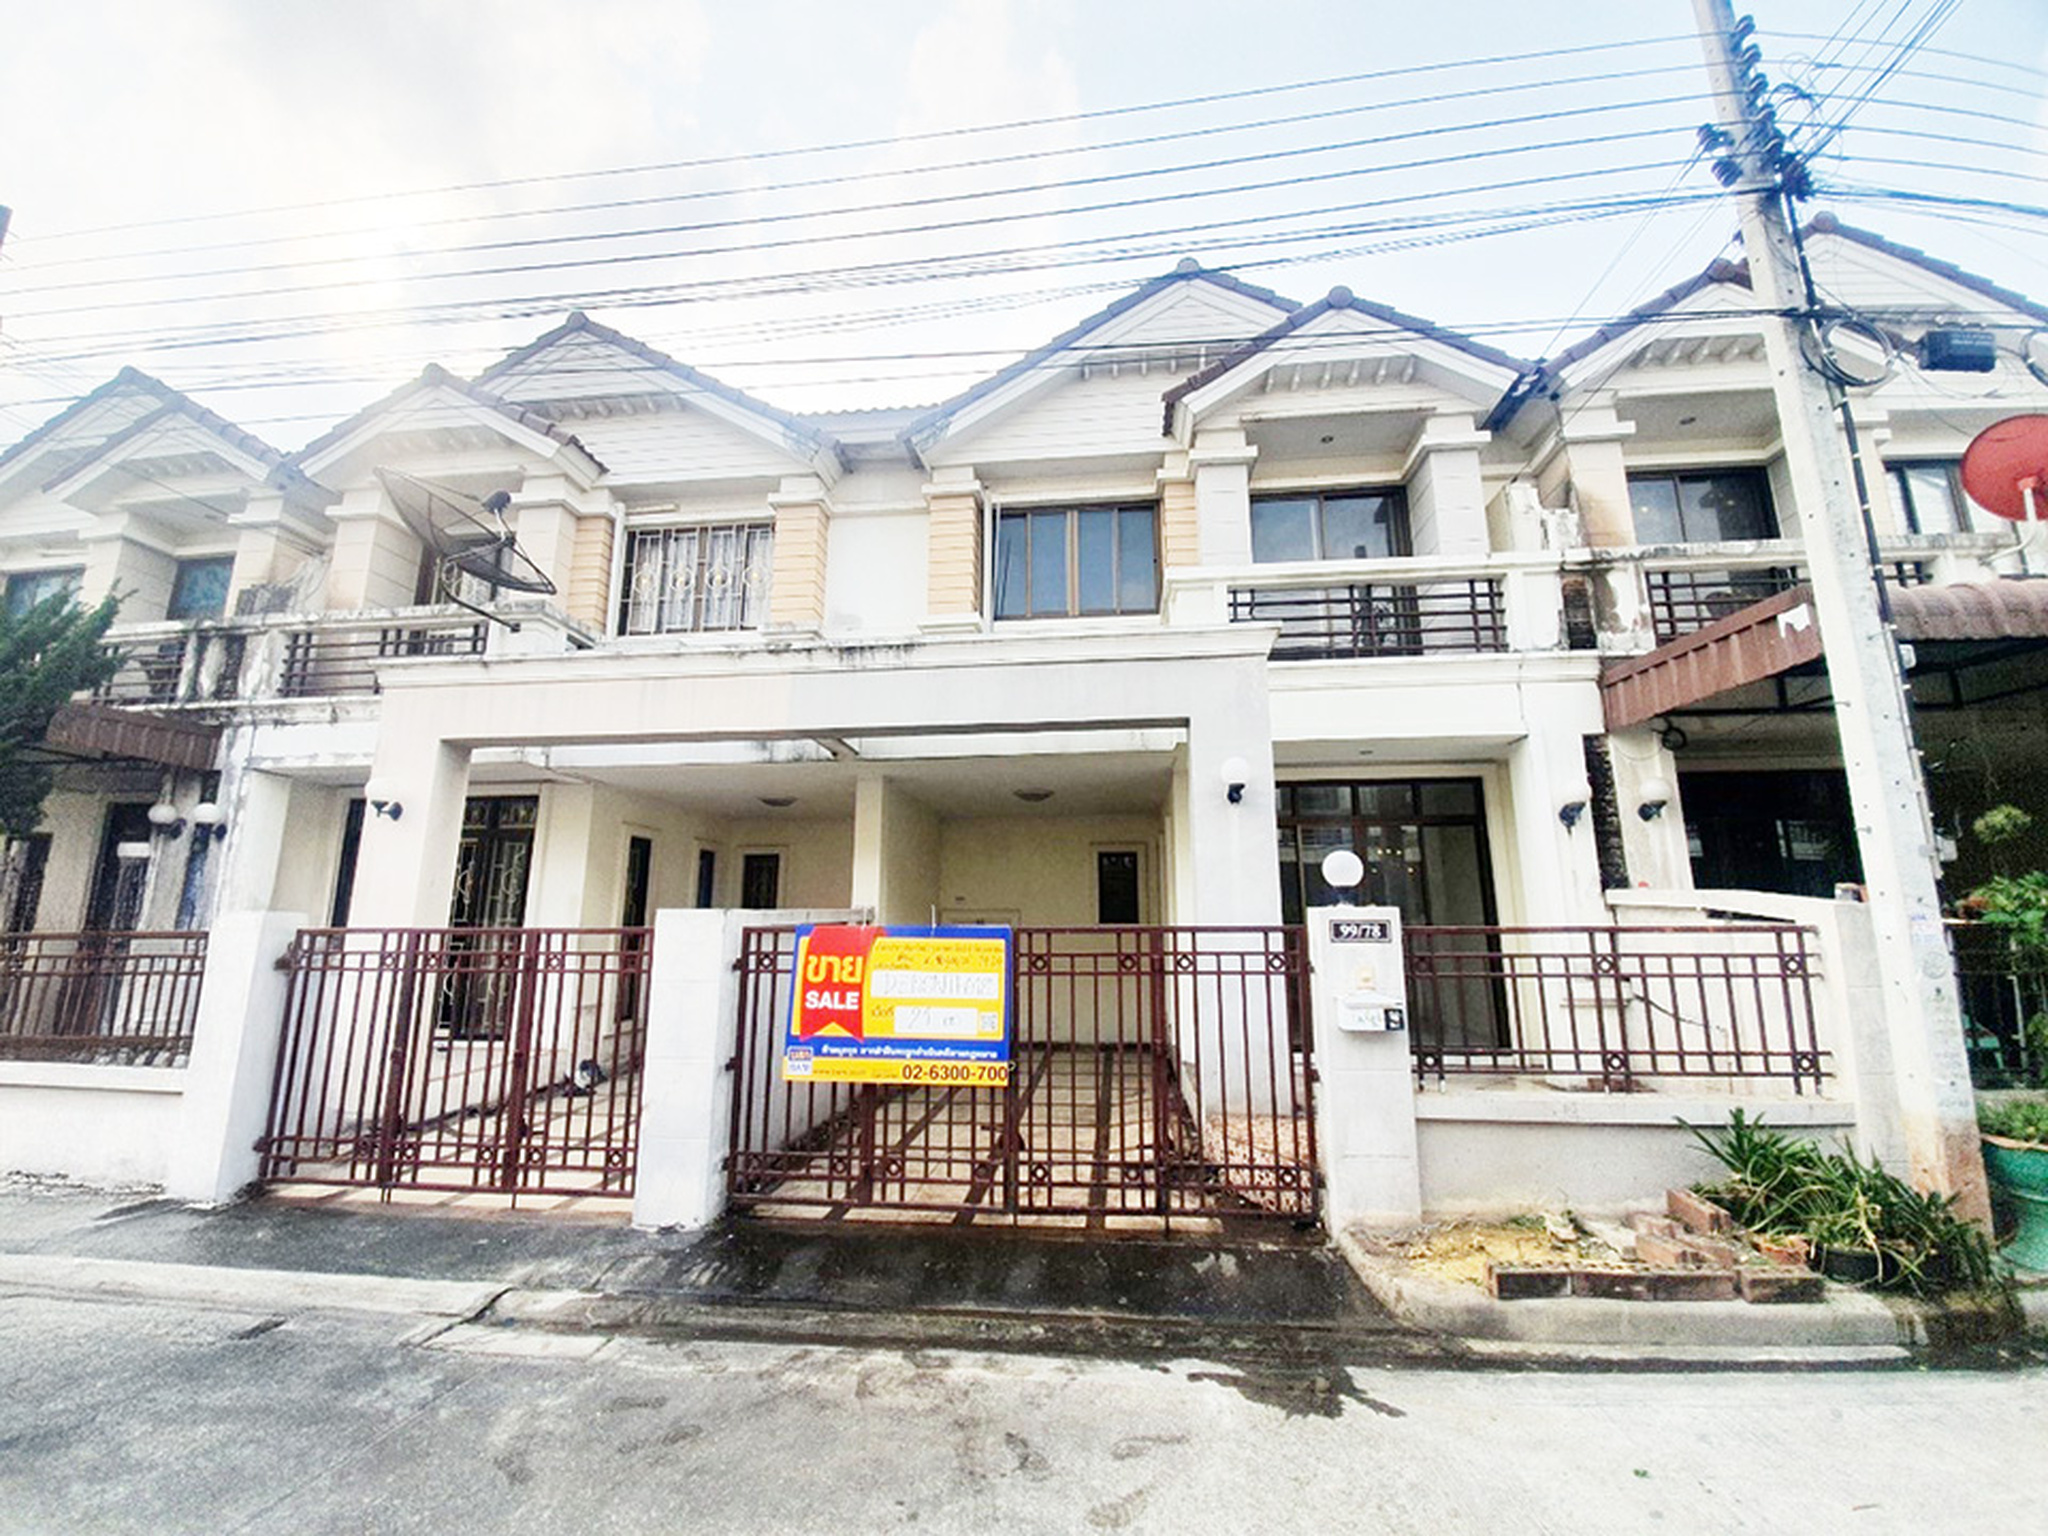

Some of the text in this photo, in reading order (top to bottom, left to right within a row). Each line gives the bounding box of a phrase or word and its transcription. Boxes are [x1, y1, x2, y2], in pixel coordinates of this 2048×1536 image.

[806, 954, 864, 984] ขาย
[804, 990, 860, 1010] SALE
[901, 1063, 1009, 1082] 02-6300-700
